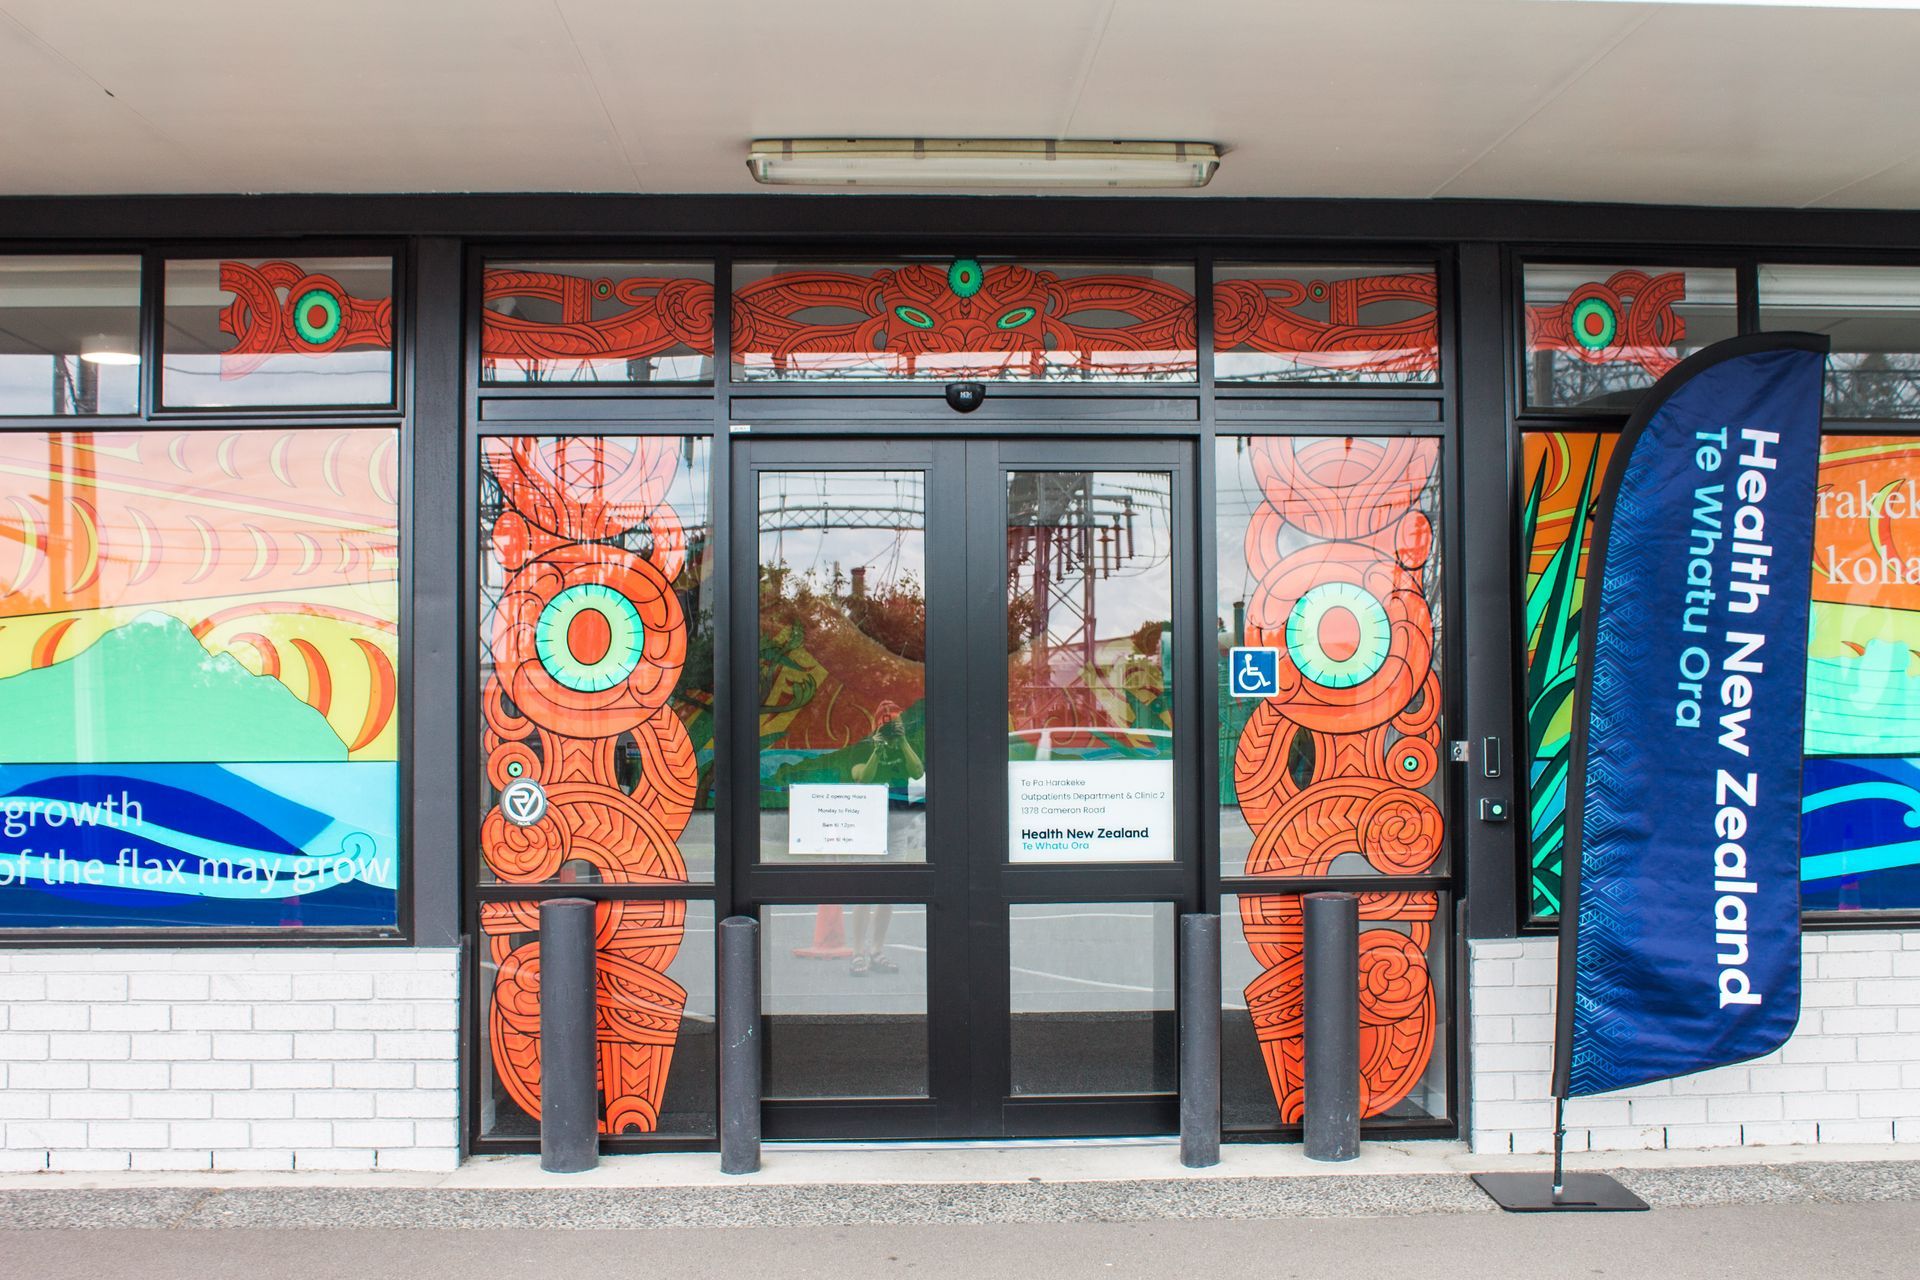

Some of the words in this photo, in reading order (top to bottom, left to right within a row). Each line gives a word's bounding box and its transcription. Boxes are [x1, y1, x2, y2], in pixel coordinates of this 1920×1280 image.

[1695, 426, 1728, 472] Te
[1727, 428, 1780, 614] Health
[1682, 484, 1725, 633] Whatu
[1675, 646, 1711, 728] Ora
[1718, 631, 1766, 757] New
[1021, 792, 1071, 801] Outpatients
[1073, 791, 1124, 801] Department
[1134, 791, 1157, 799] Clinic
[1159, 791, 1165, 799] 2
[1046, 778, 1086, 787] Harakeke
[0, 791, 143, 837] growth
[1041, 806, 1081, 814] Cameron
[1083, 806, 1106, 814] Road
[1021, 828, 1063, 840] Health
[1066, 828, 1094, 839] New
[1097, 827, 1149, 839] Zealand
[1022, 842, 1033, 850] Te
[1035, 841, 1069, 850] Whatu
[1071, 841, 1090, 850] Ora
[0, 848, 32, 886] of
[41, 849, 105, 885] the
[116, 848, 187, 885] flax
[200, 857, 282, 894] may
[292, 857, 391, 894] grow
[1714, 769, 1762, 1010] Zealand
